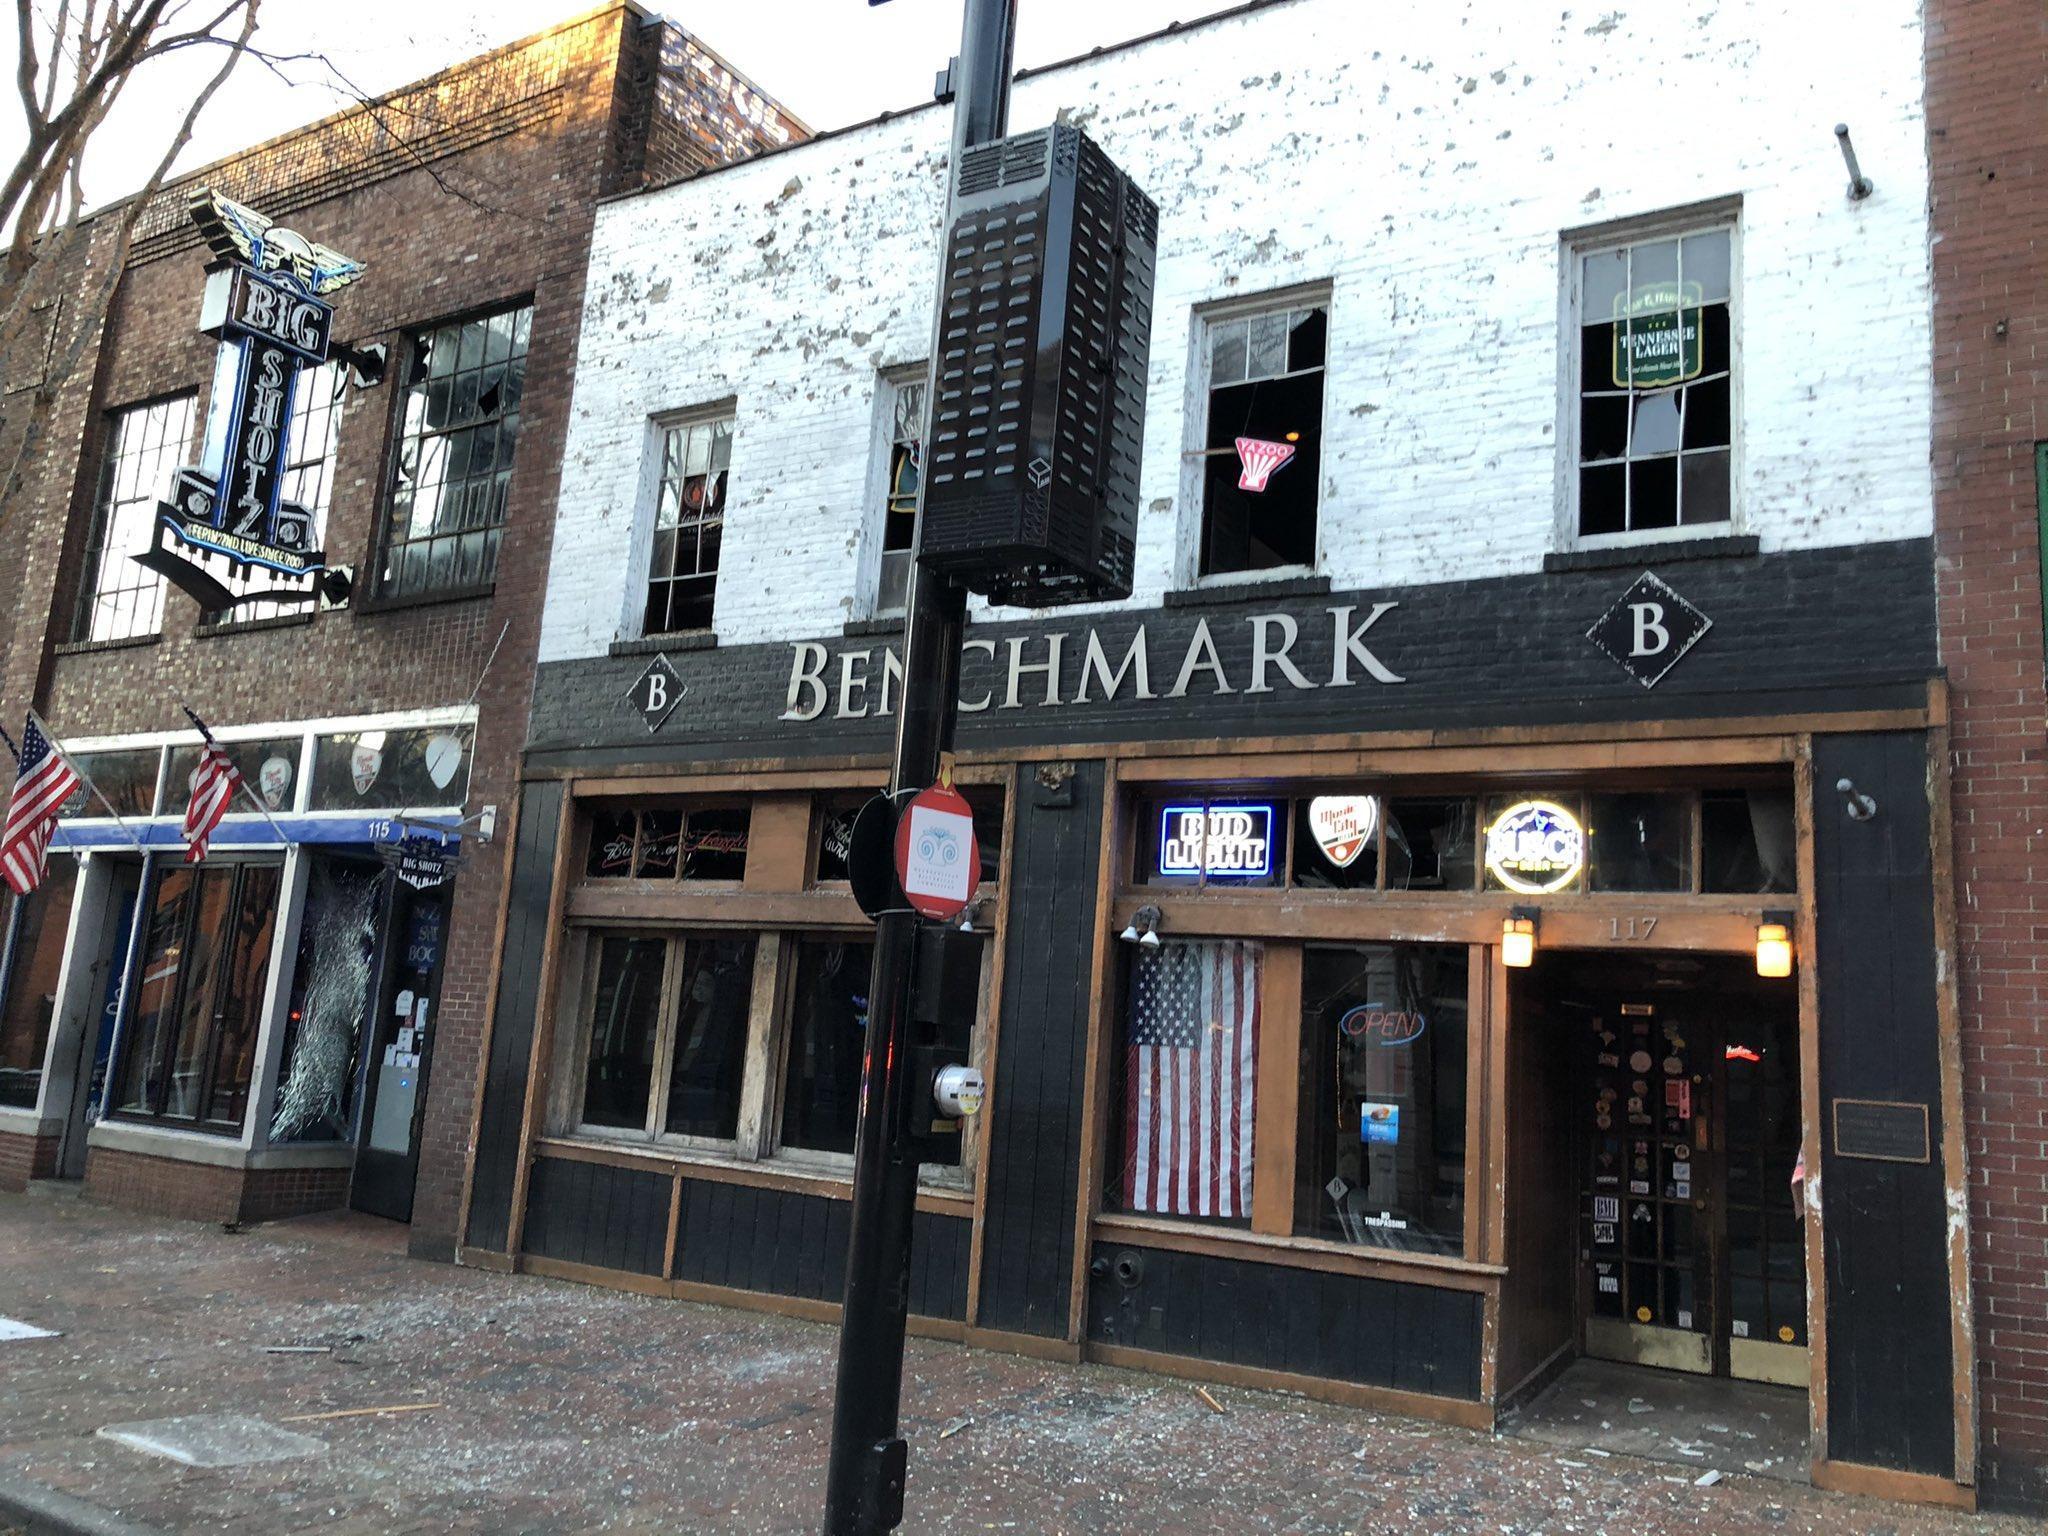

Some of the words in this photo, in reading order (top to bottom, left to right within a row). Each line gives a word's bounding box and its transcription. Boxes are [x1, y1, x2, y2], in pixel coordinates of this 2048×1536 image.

[242, 281, 323, 350] BIG
[1636, 341, 1679, 359] LAGER
[232, 349, 284, 538] SHOTZ
[1241, 439, 1288, 457] YAZOO
[1627, 602, 1670, 657] B
[778, 601, 1406, 722] BENCHMARK
[645, 673, 668, 713] B
[368, 821, 390, 839] 115
[1181, 812, 1253, 841] BUD
[402, 857, 417, 869] BIG
[418, 861, 442, 874] SHOTZ
[1609, 917, 1657, 941] 117
[1348, 1011, 1417, 1036] OPEN
[1364, 1216, 1407, 1230] TRESPASSING
[1380, 1211, 1391, 1220] NO
